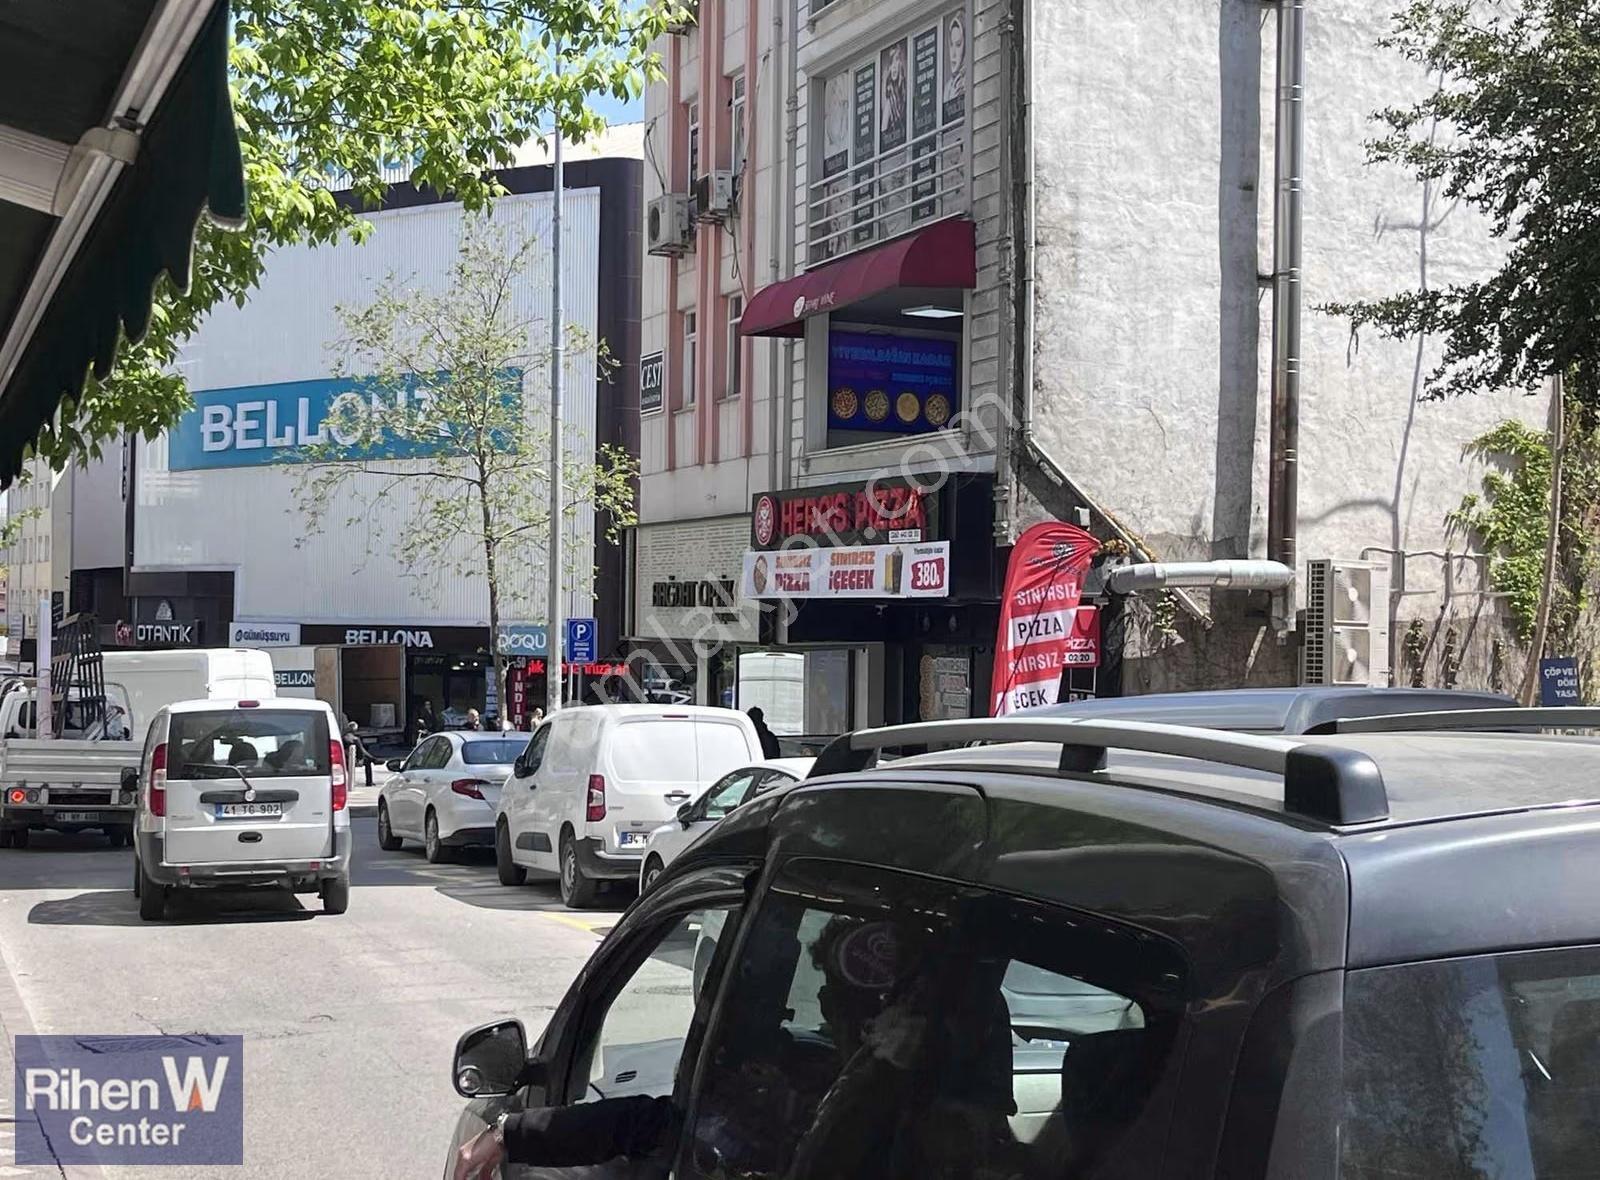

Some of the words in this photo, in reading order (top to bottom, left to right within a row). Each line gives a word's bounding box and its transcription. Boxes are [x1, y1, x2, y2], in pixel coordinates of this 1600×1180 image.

[345, 629, 434, 648] BELLONA
[576, 624, 587, 640] P
[223, 804, 236, 815] 41
